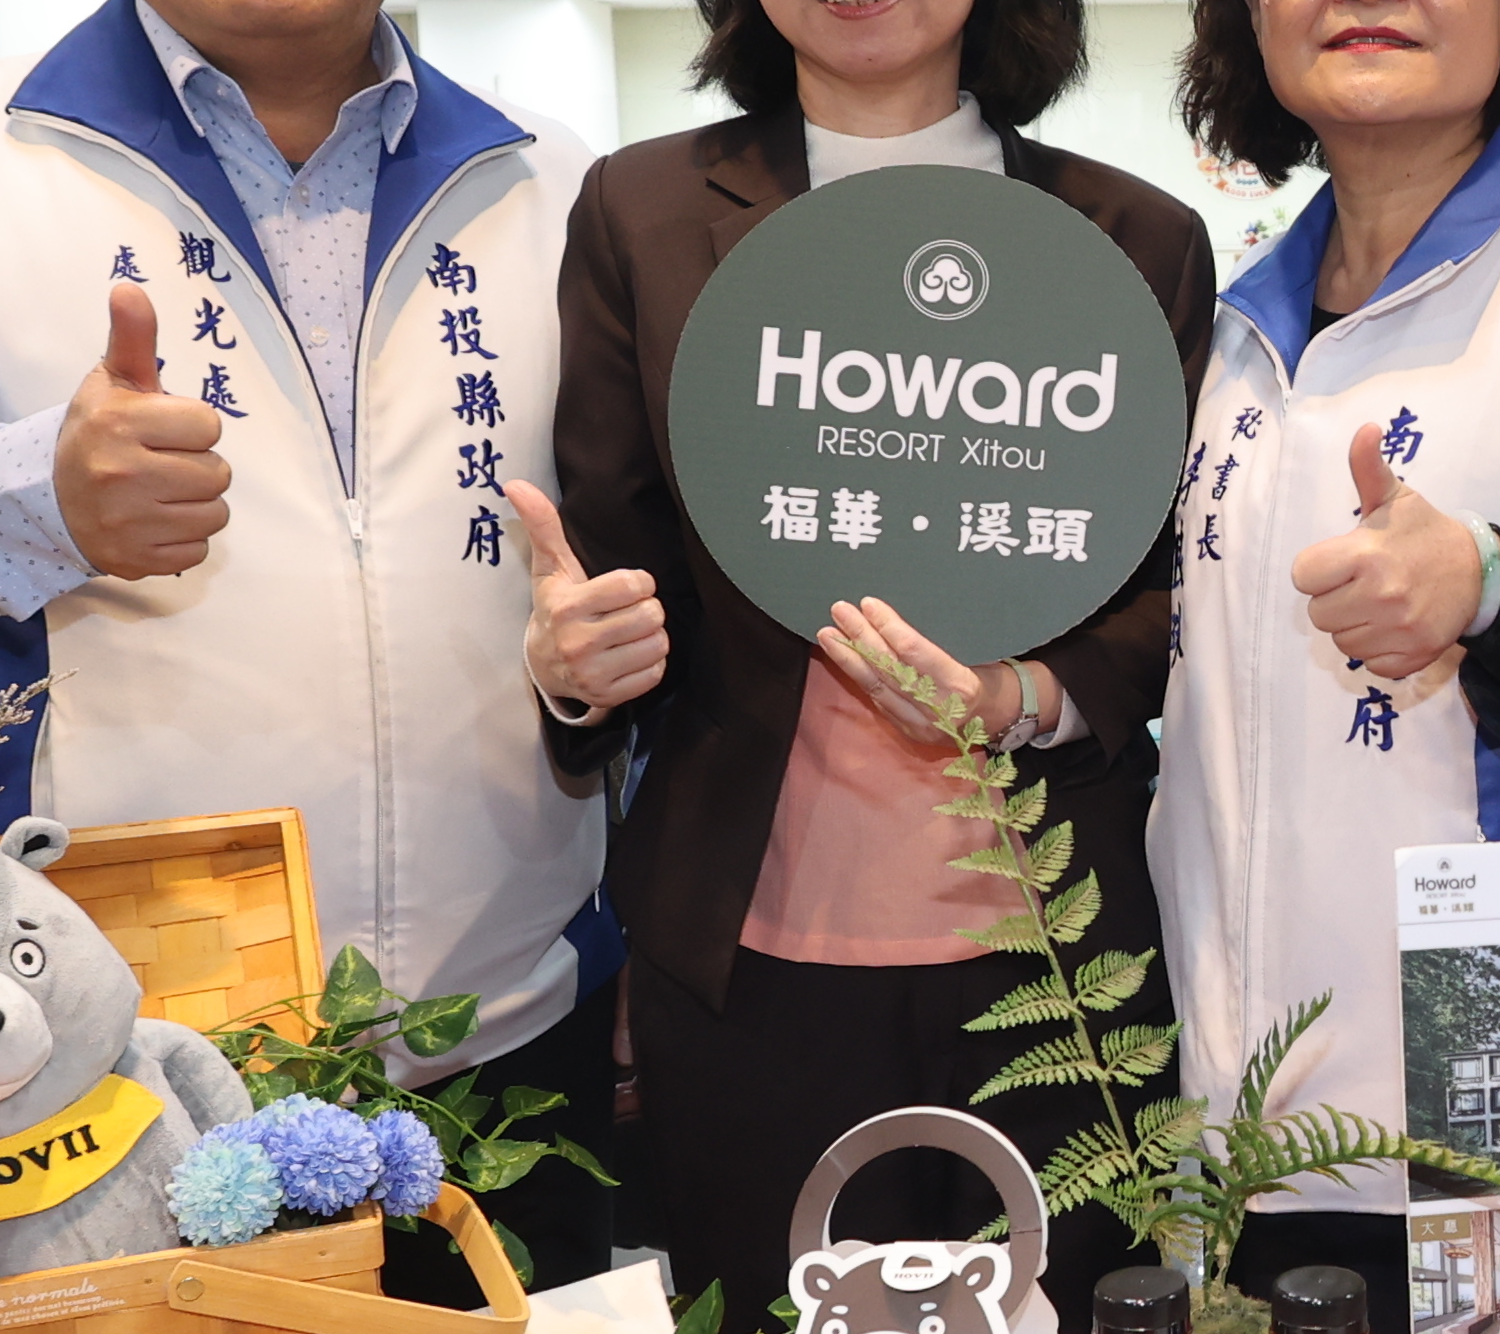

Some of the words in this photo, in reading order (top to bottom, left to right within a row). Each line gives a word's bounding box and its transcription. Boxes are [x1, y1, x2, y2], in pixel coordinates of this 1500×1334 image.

[178, 230, 249, 419] 觀光處
[426, 241, 506, 567] 南投縣政府
[756, 326, 1118, 433] Howard
[816, 425, 946, 463] RESORT
[959, 435, 1046, 471] Xitou
[1197, 406, 1263, 561] 秘書長
[1414, 874, 1477, 893] Howard
[11, 1277, 98, 1306] normale
